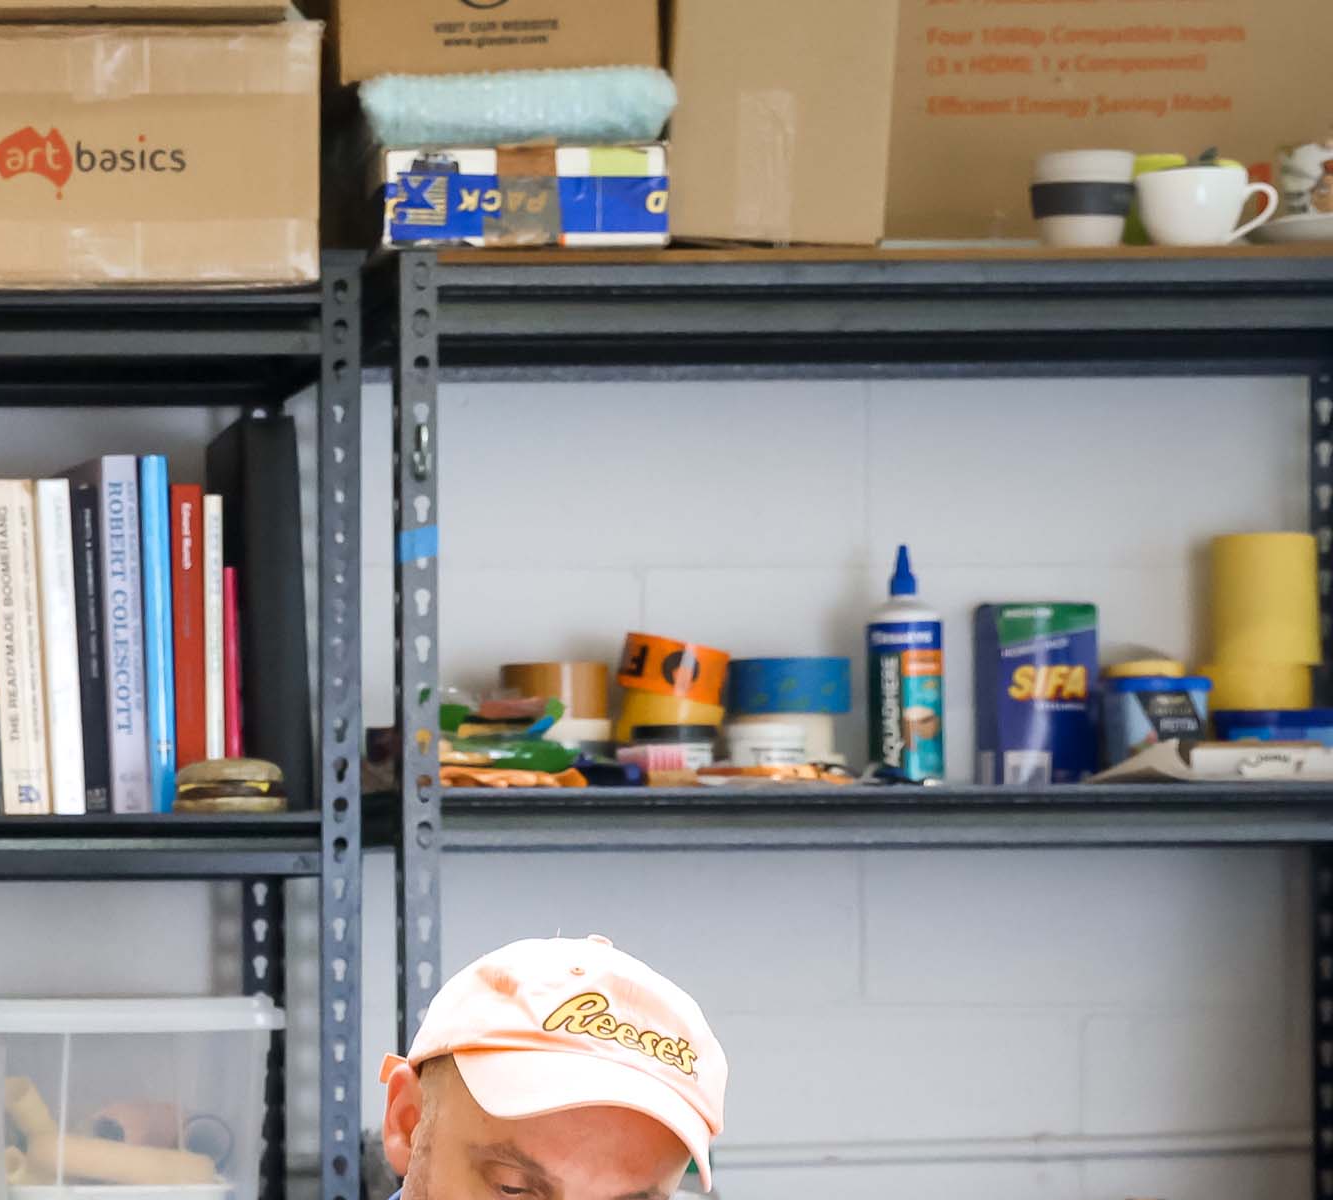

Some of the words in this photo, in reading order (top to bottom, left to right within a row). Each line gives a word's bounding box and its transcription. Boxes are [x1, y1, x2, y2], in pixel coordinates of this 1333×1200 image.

[5, 140, 64, 172] art
[75, 133, 188, 173] basics
[108, 481, 126, 580] ROBERT
[3, 612, 19, 712] READYMADE
[112, 589, 133, 733] COLESCOTT
[7, 714, 20, 742] THE
[880, 655, 906, 767] AQUADHERE
[543, 992, 697, 1075] Reese's
